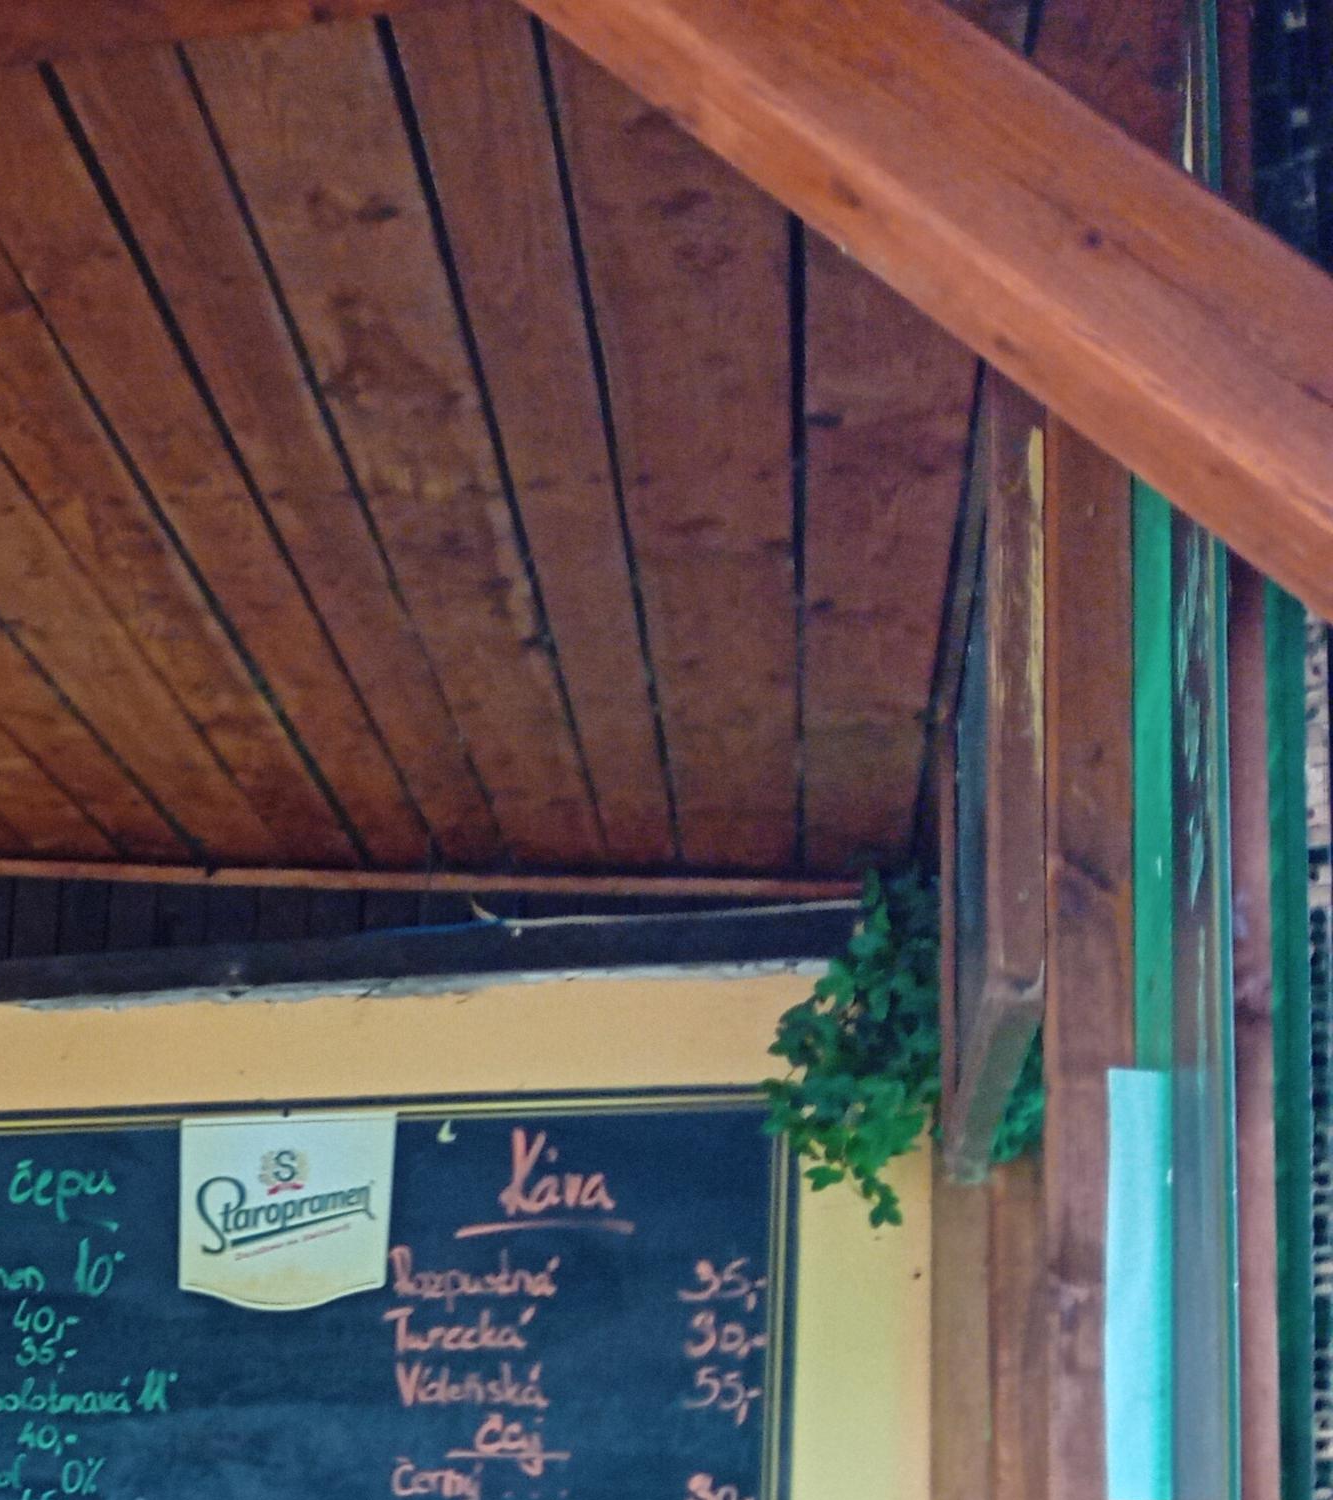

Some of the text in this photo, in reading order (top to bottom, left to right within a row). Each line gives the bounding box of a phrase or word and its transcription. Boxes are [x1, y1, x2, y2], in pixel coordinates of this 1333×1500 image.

[8, 1158, 117, 1224] čepu
[196, 1176, 375, 1256] Staropramen
[382, 1304, 538, 1355] Turecká
